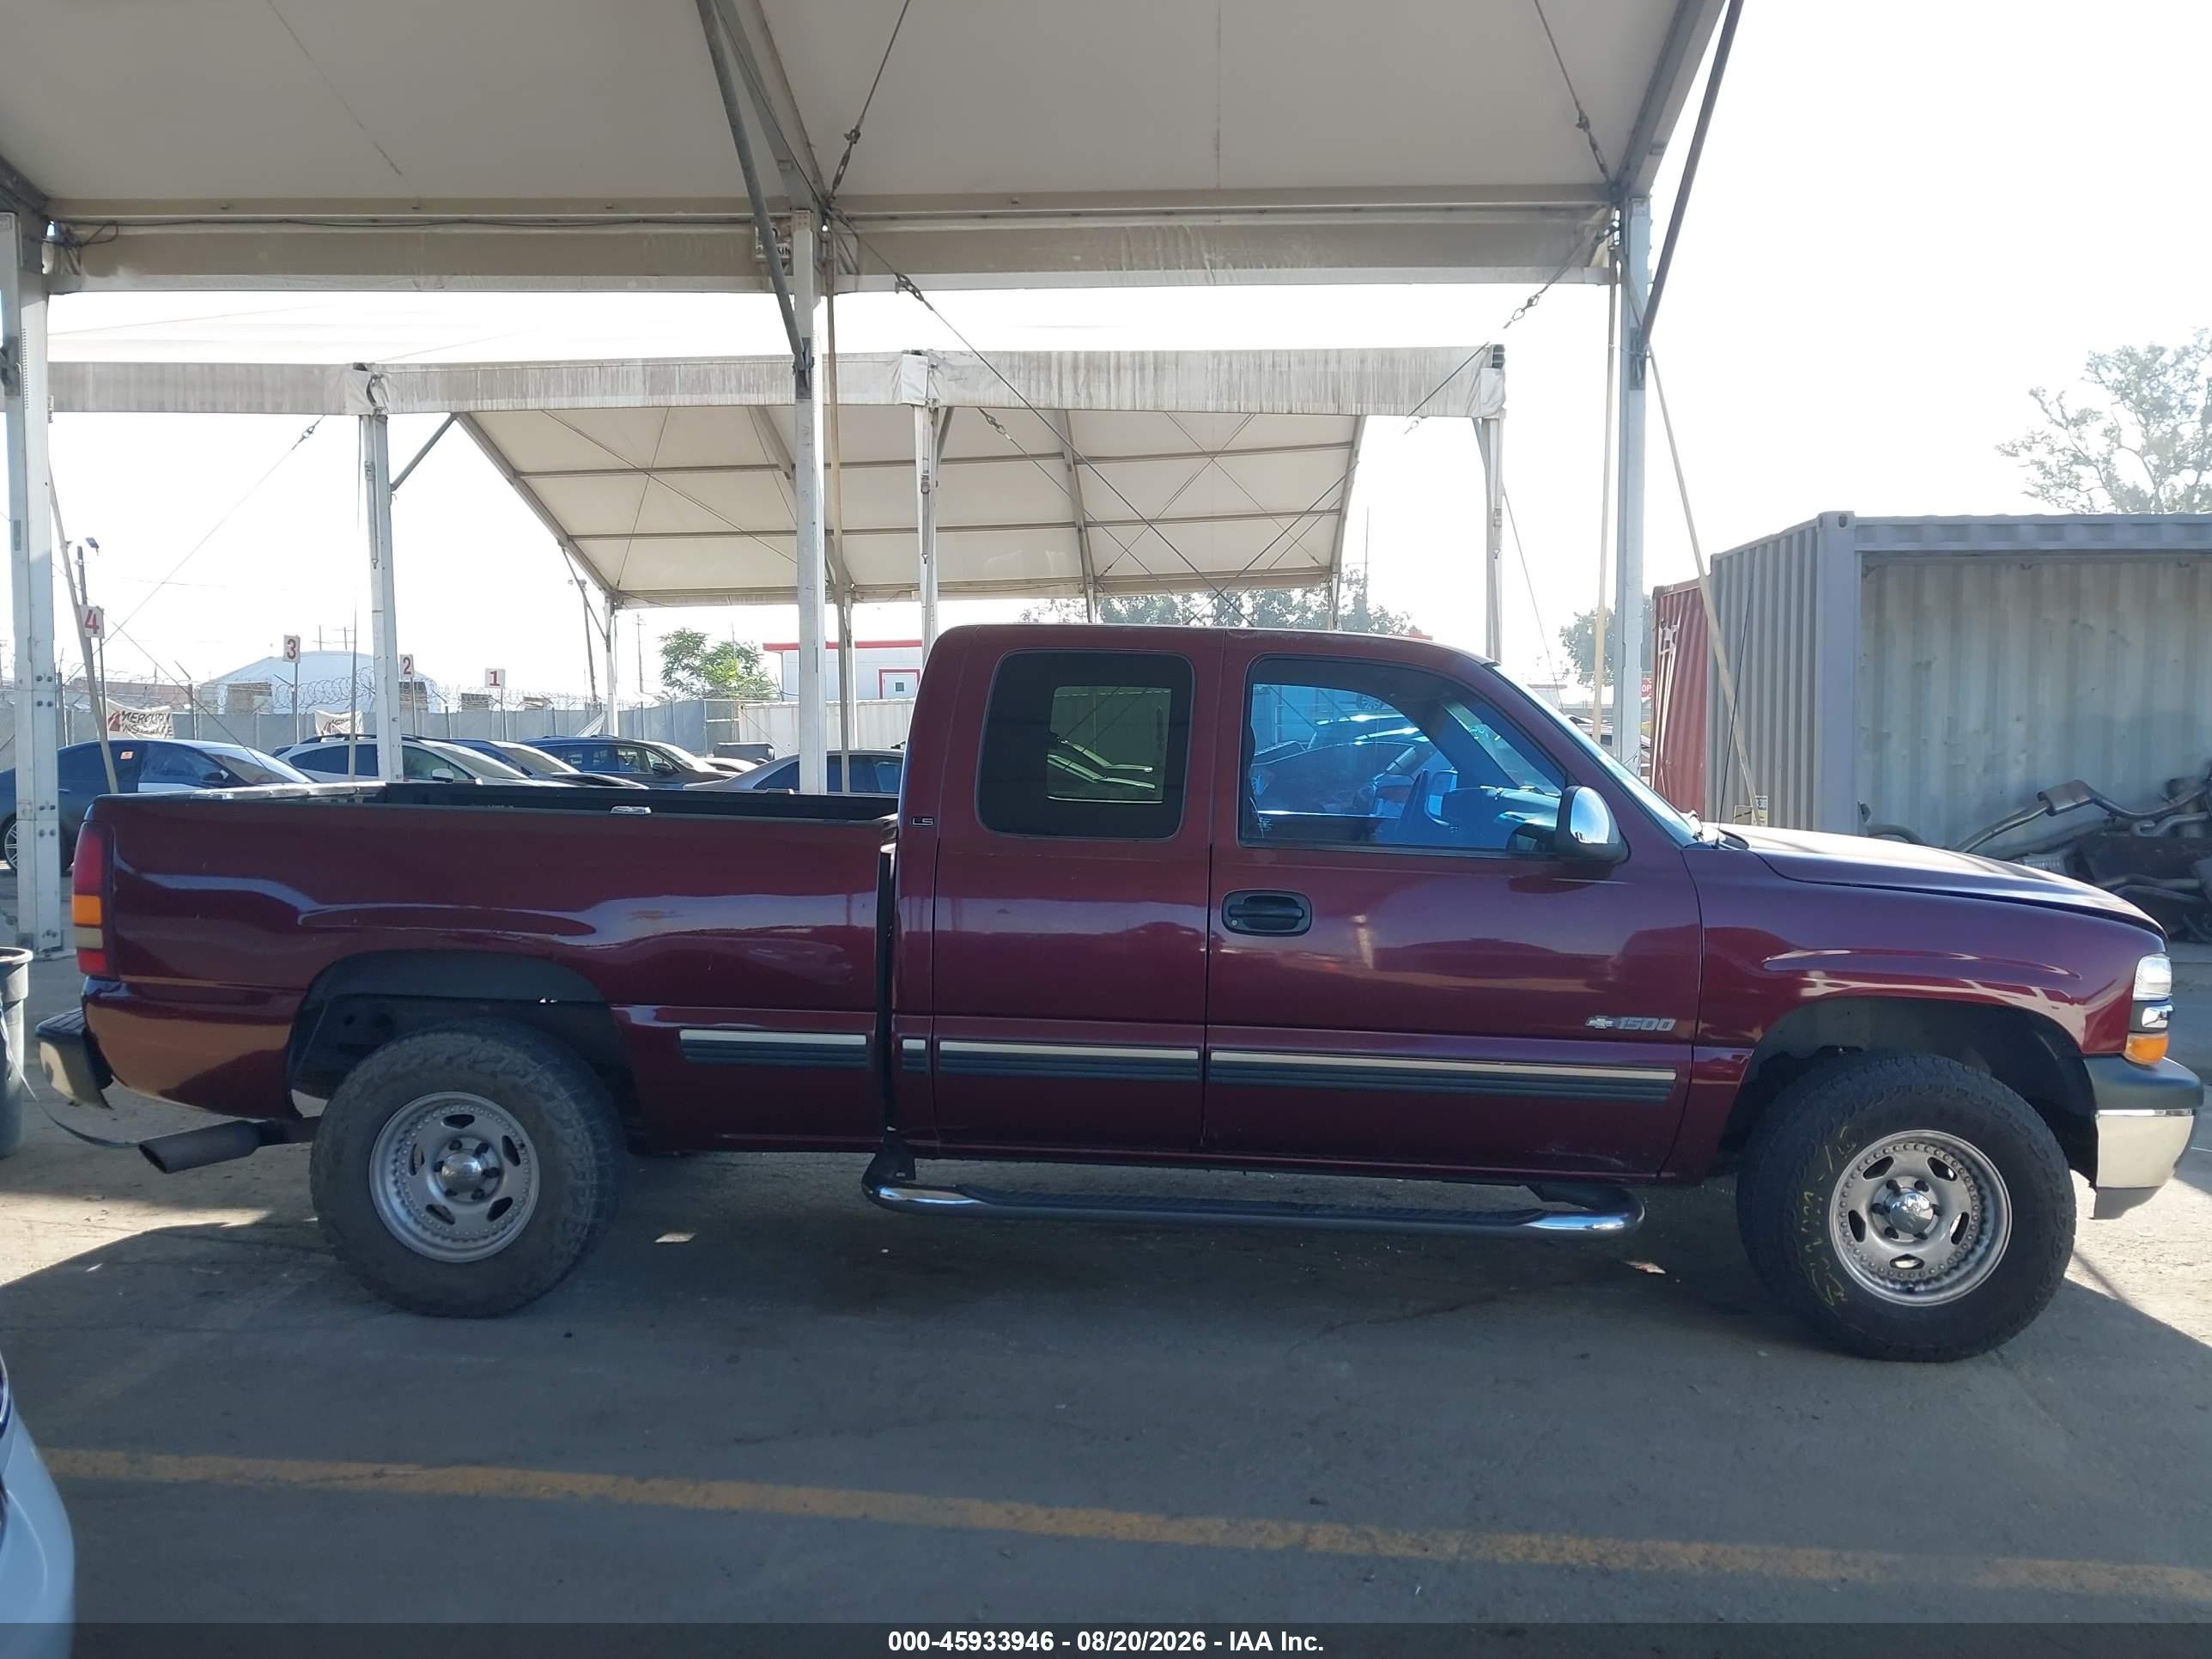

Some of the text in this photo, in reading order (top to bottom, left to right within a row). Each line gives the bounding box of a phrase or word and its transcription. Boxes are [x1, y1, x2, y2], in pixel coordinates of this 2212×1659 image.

[84, 609, 100, 635] 4
[287, 638, 297, 660] 3
[403, 656, 412, 675] 2
[489, 670, 501, 687] 1
[912, 817, 934, 826] LS
[1616, 1016, 1677, 1031] 1500
